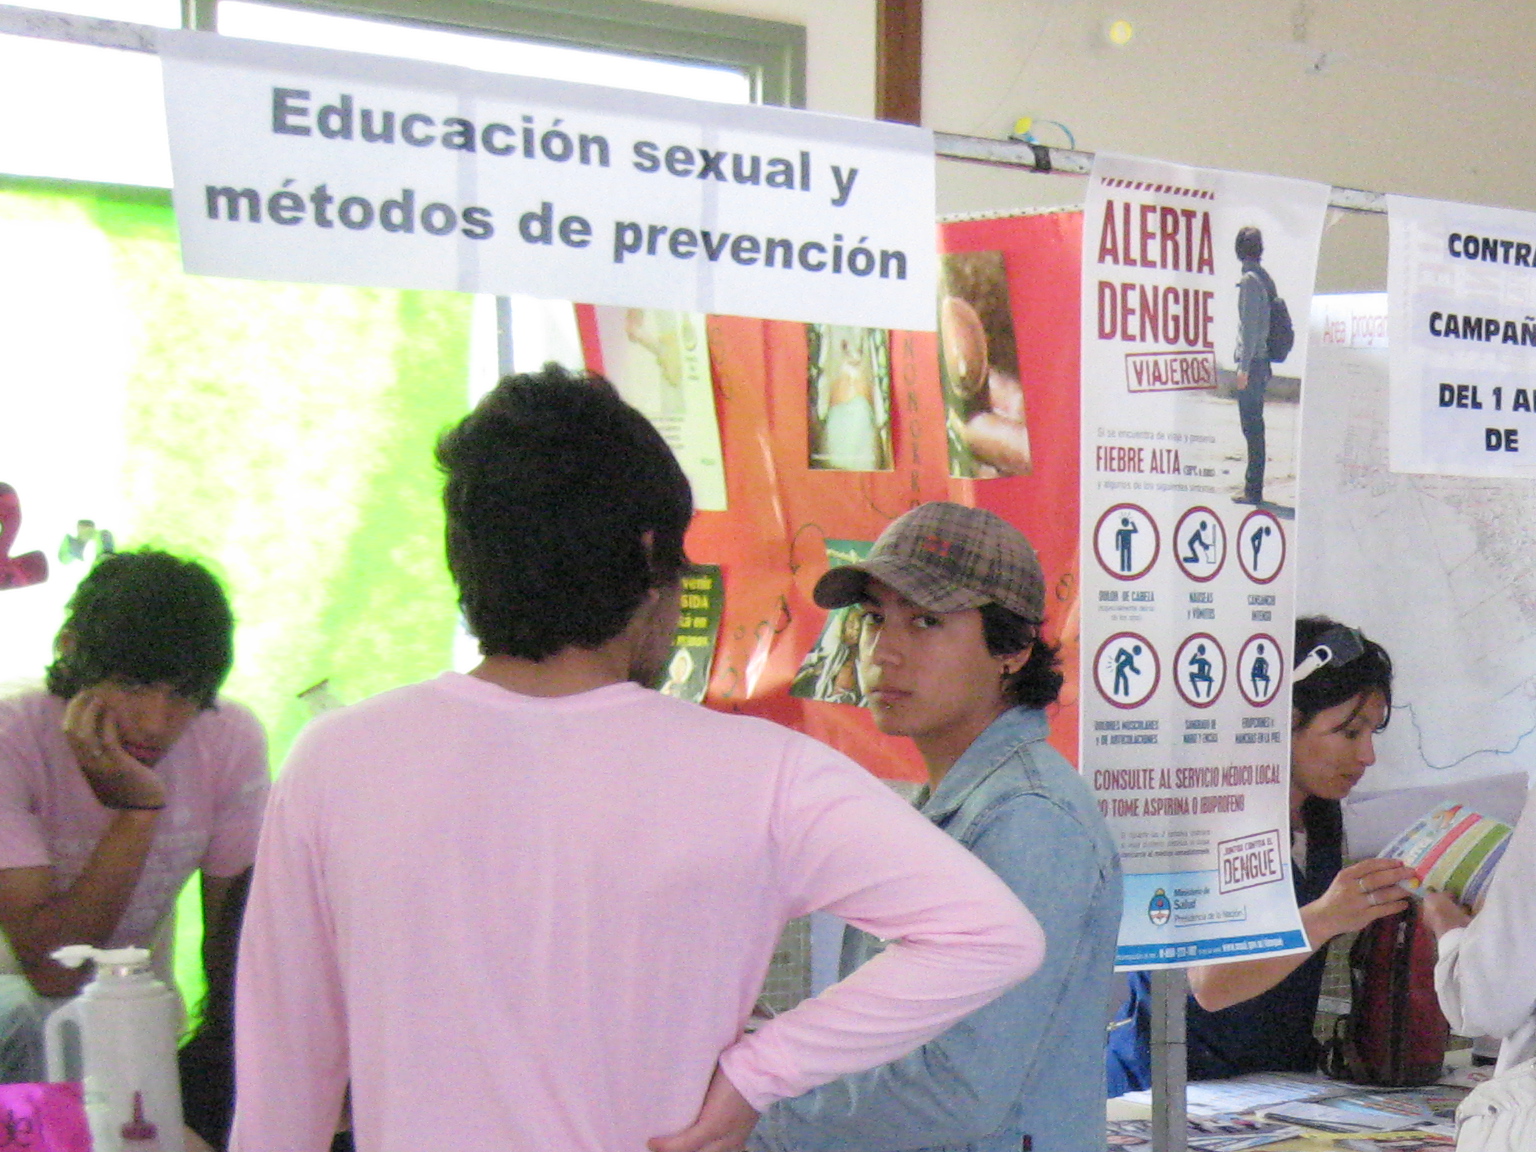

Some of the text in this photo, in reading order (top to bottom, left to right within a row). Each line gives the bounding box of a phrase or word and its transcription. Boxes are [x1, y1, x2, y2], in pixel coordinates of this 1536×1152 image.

[271, 86, 859, 208] Educación sexual y
[205, 177, 908, 280] métodos de prevención
[1097, 198, 1215, 275] ALERTA
[1097, 279, 1215, 350] DENGUE
[1132, 355, 1212, 388] VIAJEROS
[1438, 381, 1483, 411] DEL
[1491, 386, 1502, 412] 1
[1484, 428, 1520, 454] DE
[1096, 445, 1145, 474] FIEBRE
[1149, 447, 1181, 476] ALTA
[1093, 767, 1155, 792] CONSULTE
[1158, 767, 1172, 791] AL
[1175, 766, 1220, 789] SERVICIO
[1112, 797, 1140, 818] TOME
[1143, 796, 1190, 818] ASPIRINA
[1223, 848, 1277, 886] DENGUE
